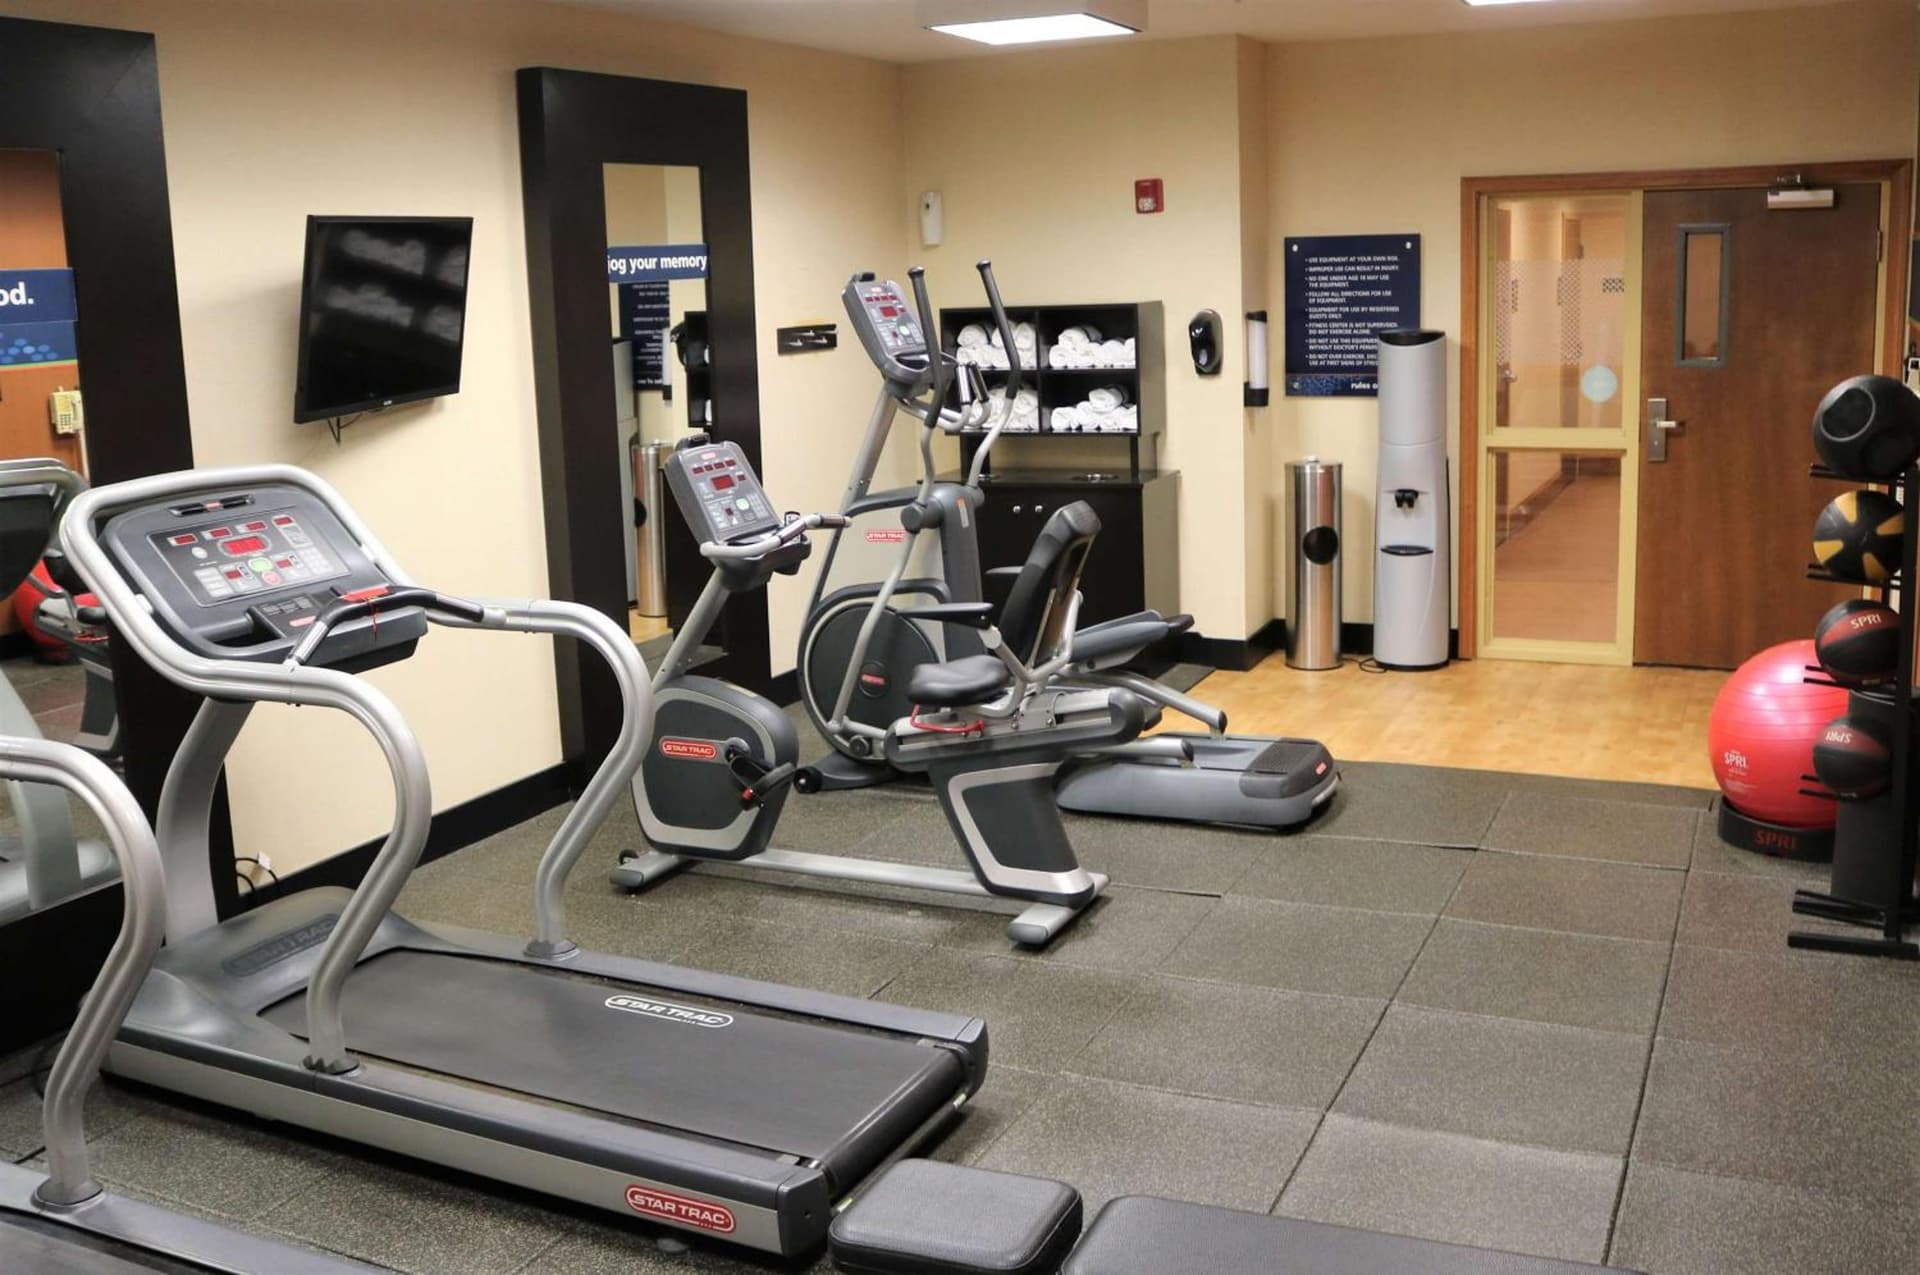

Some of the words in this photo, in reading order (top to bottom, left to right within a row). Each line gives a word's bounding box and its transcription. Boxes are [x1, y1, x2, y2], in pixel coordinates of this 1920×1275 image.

[629, 256, 658, 274] your
[660, 255, 708, 271] memory
[1351, 381, 1370, 390] rules
[1850, 613, 1882, 629] SPRI
[1825, 730, 1853, 744] SPRI
[666, 744, 688, 752] STAR
[689, 746, 713, 755] TRAC
[1724, 752, 1747, 768] SPRI
[1754, 830, 1797, 849] SPRI
[616, 998, 666, 1013] STAR
[667, 1008, 725, 1023] TRAC
[633, 1194, 677, 1213] STAR
[678, 1205, 726, 1225] TRAC
